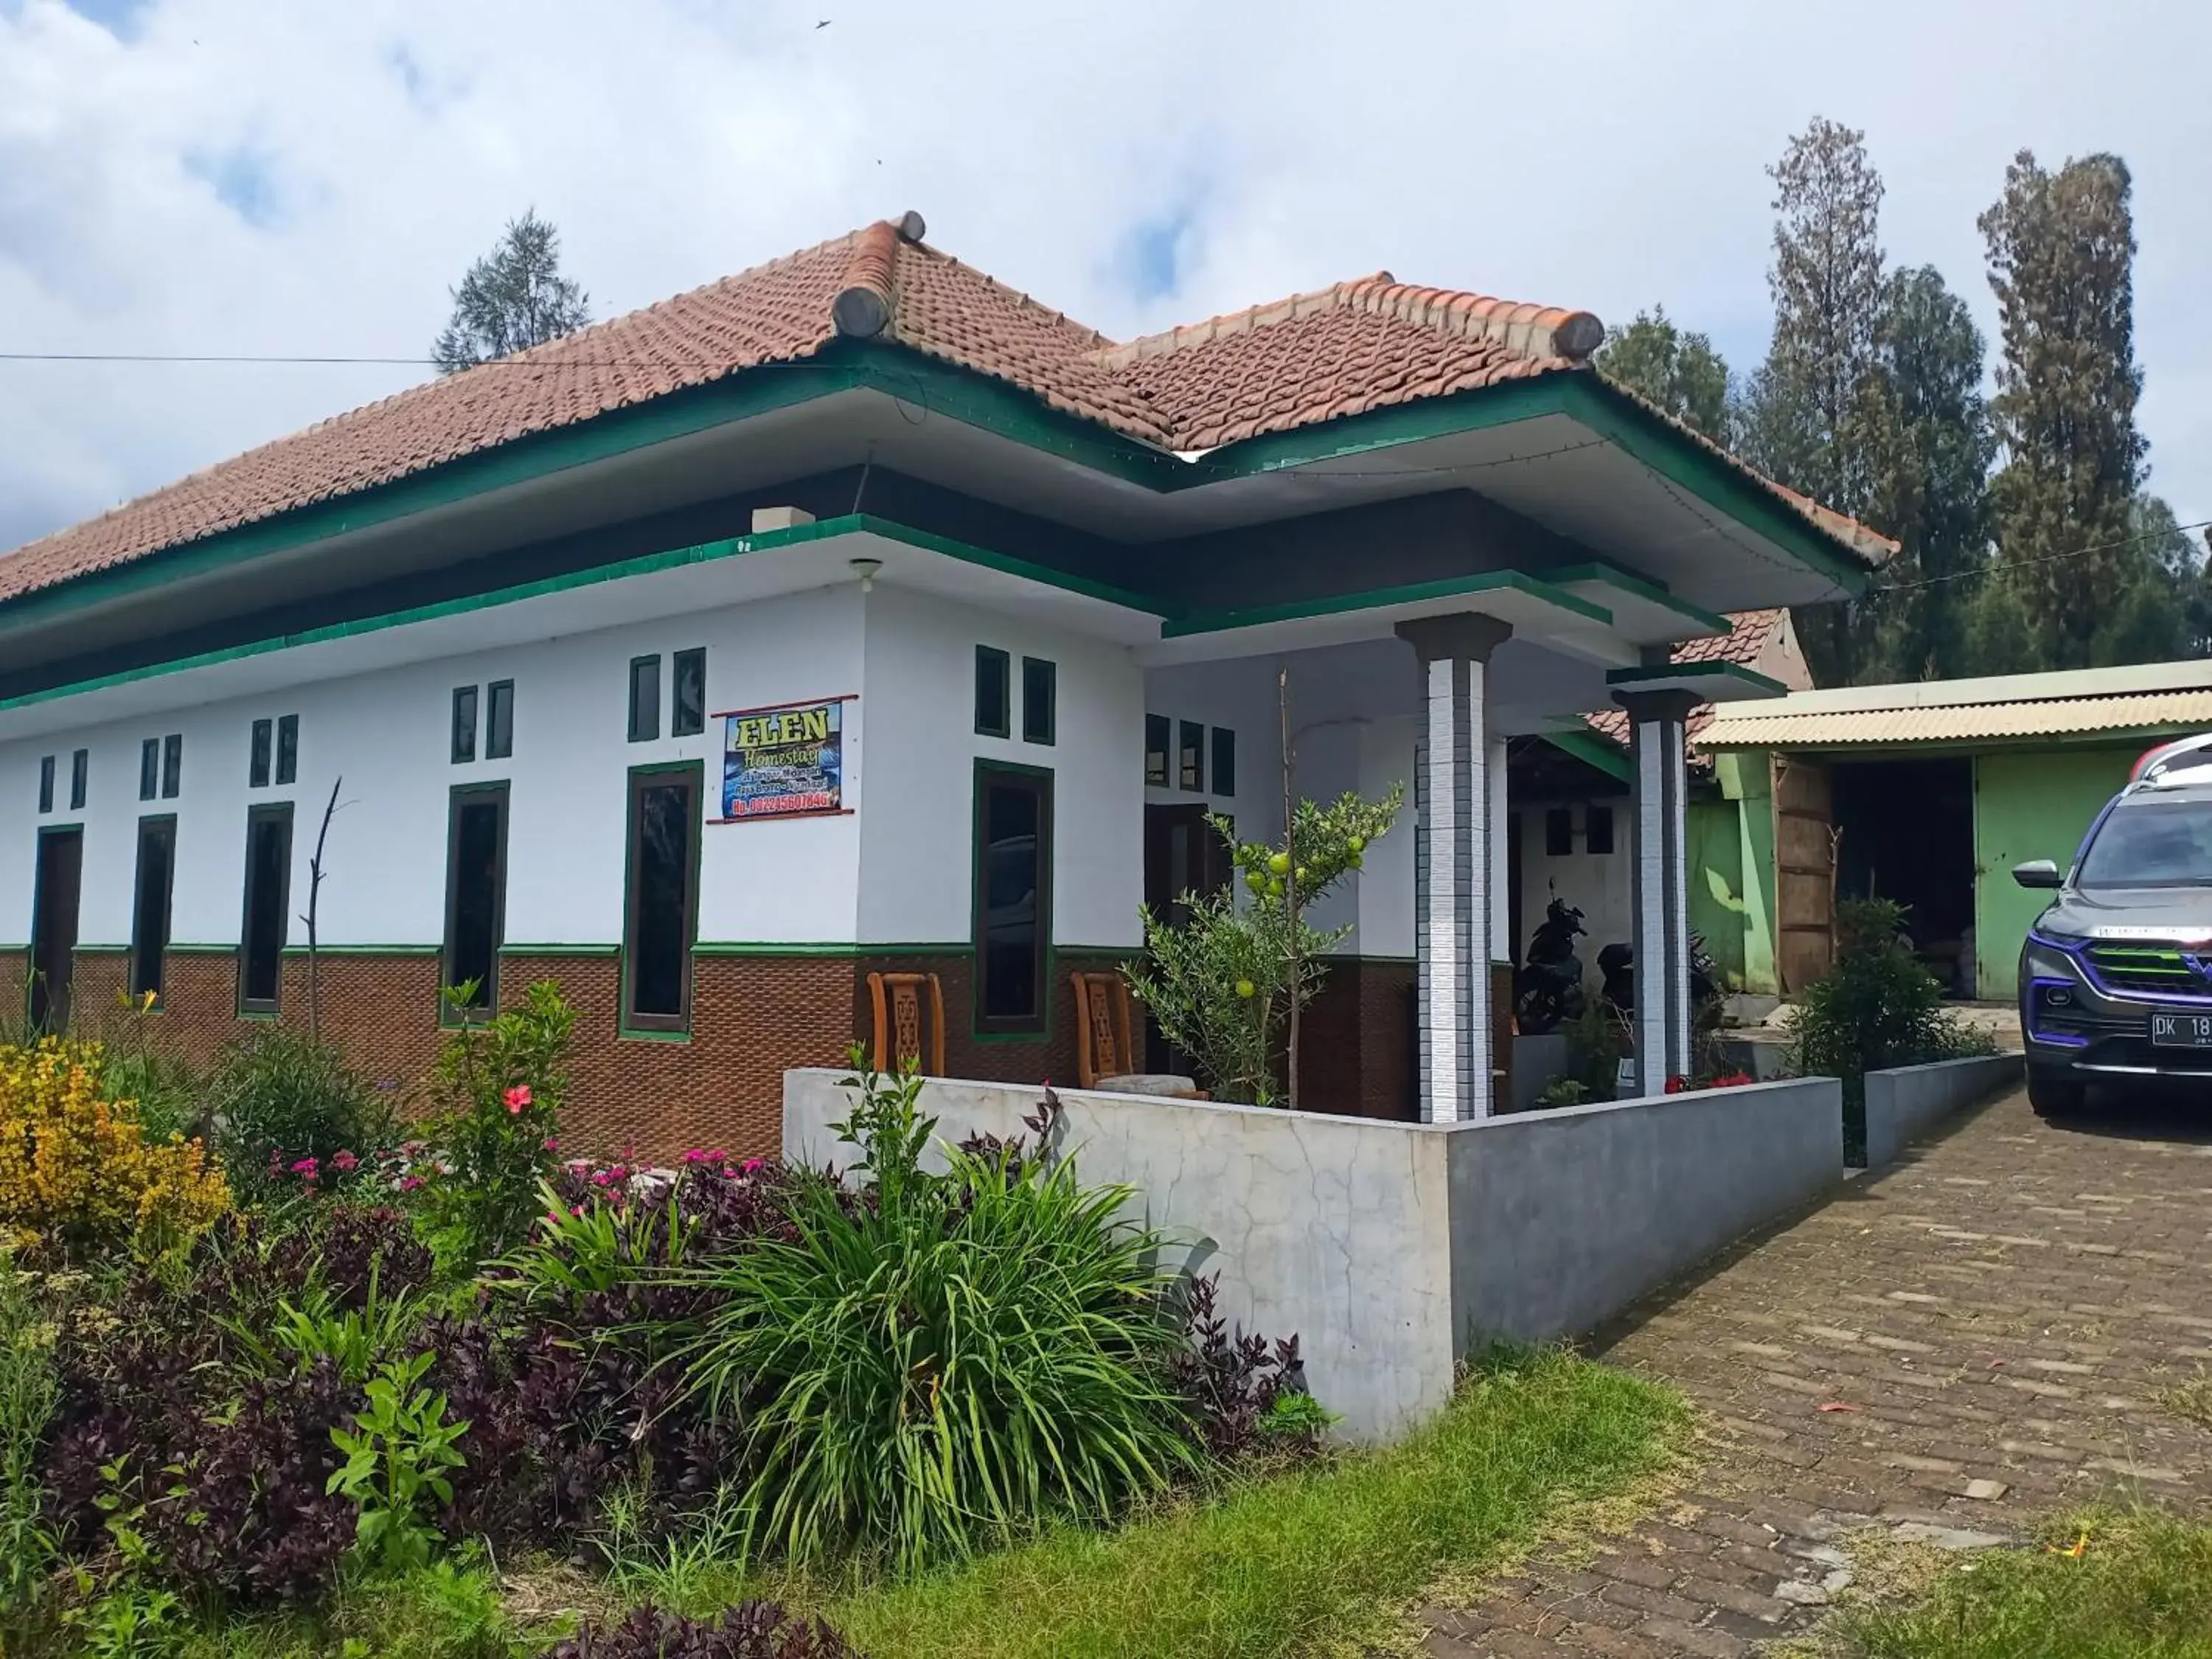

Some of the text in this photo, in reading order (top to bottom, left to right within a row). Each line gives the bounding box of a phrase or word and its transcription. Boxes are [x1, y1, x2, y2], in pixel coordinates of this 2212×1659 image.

[737, 709, 827, 748] ELEN
[745, 748, 818, 768] Homestay
[2155, 1018, 2175, 1035] DK
